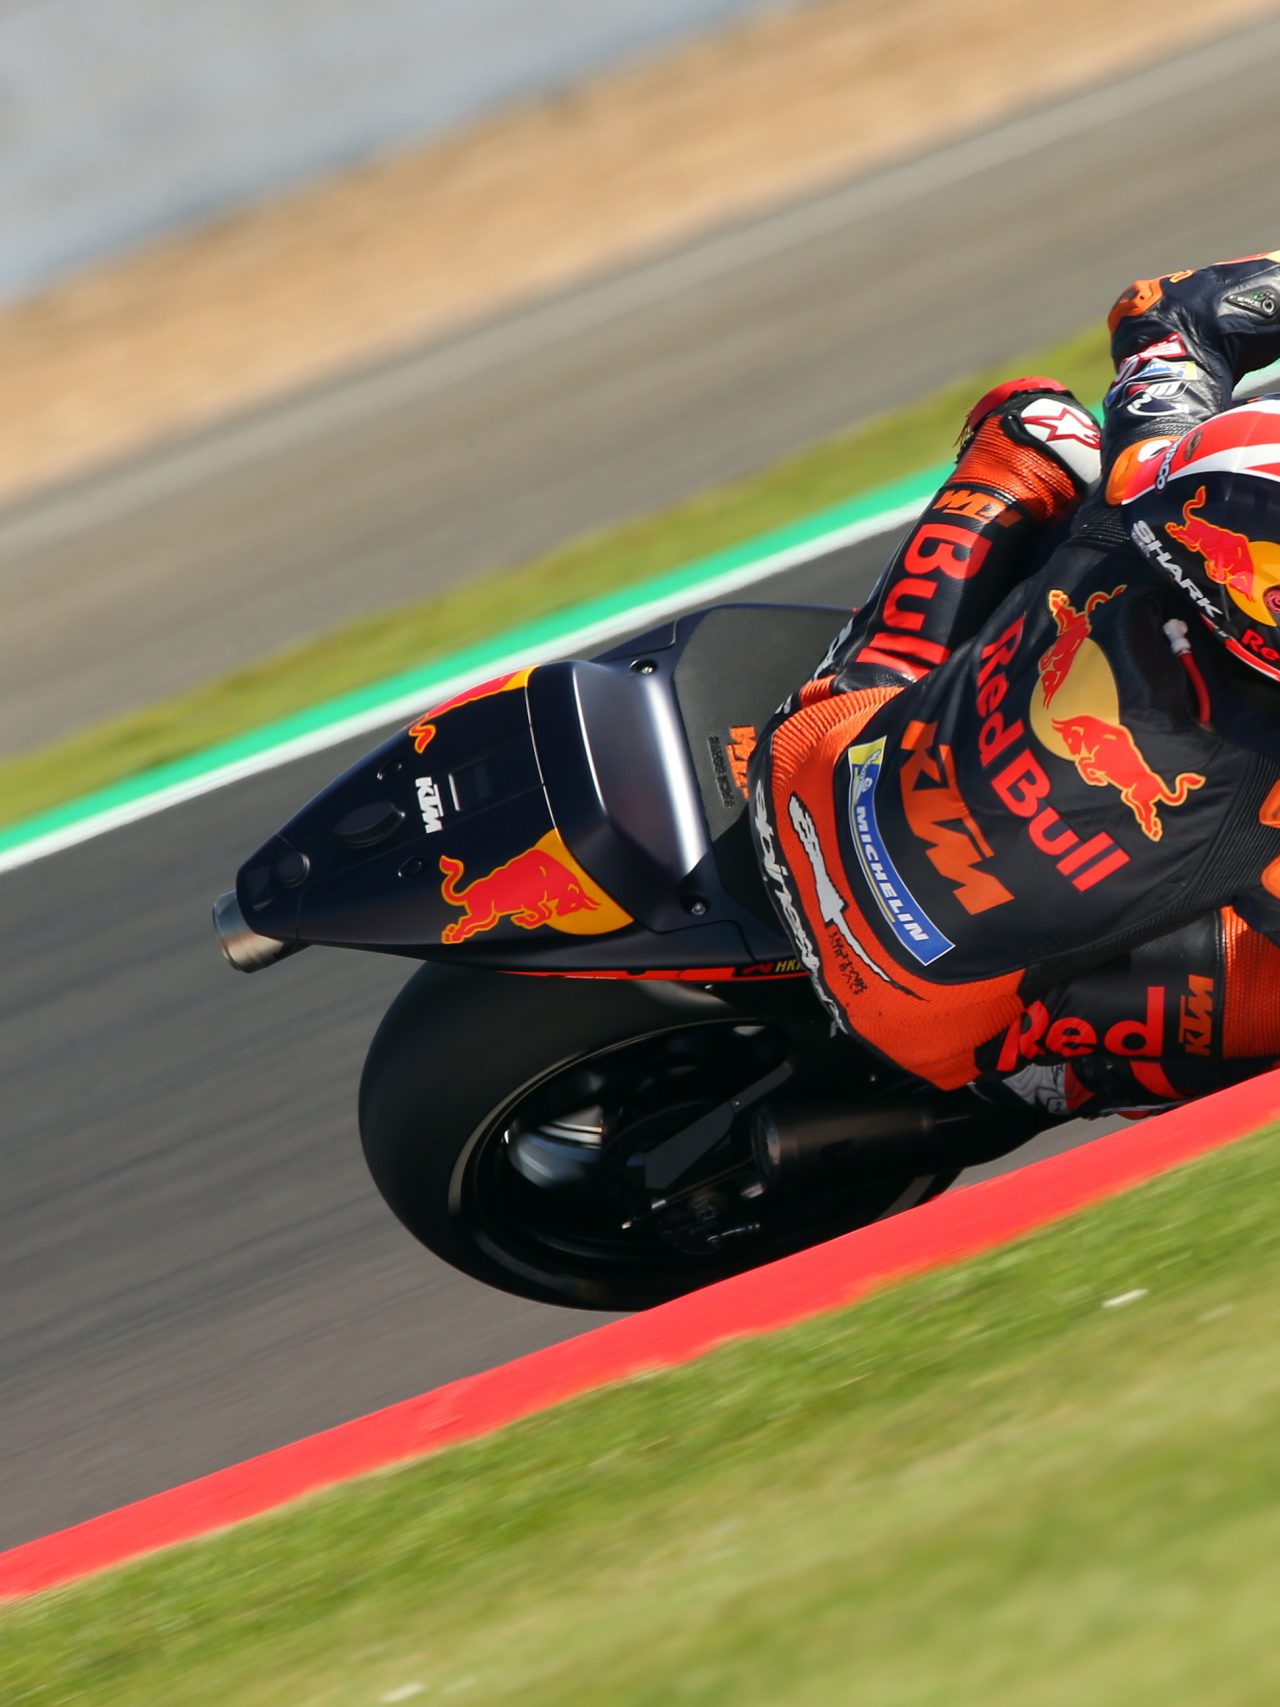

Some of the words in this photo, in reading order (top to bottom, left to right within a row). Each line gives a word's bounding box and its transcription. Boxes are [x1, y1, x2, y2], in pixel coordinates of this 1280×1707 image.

[932, 488, 1024, 529] KTM
[854, 522, 993, 682] Bull
[1131, 520, 1224, 619] SHARK
[976, 612, 1026, 768] Red
[415, 776, 444, 834] KTM
[900, 720, 1015, 916] KTM
[991, 754, 1131, 893] Bull
[854, 805, 929, 944] MICHELIN
[996, 986, 1165, 1072] Red
[1177, 974, 1214, 1056] KTM
